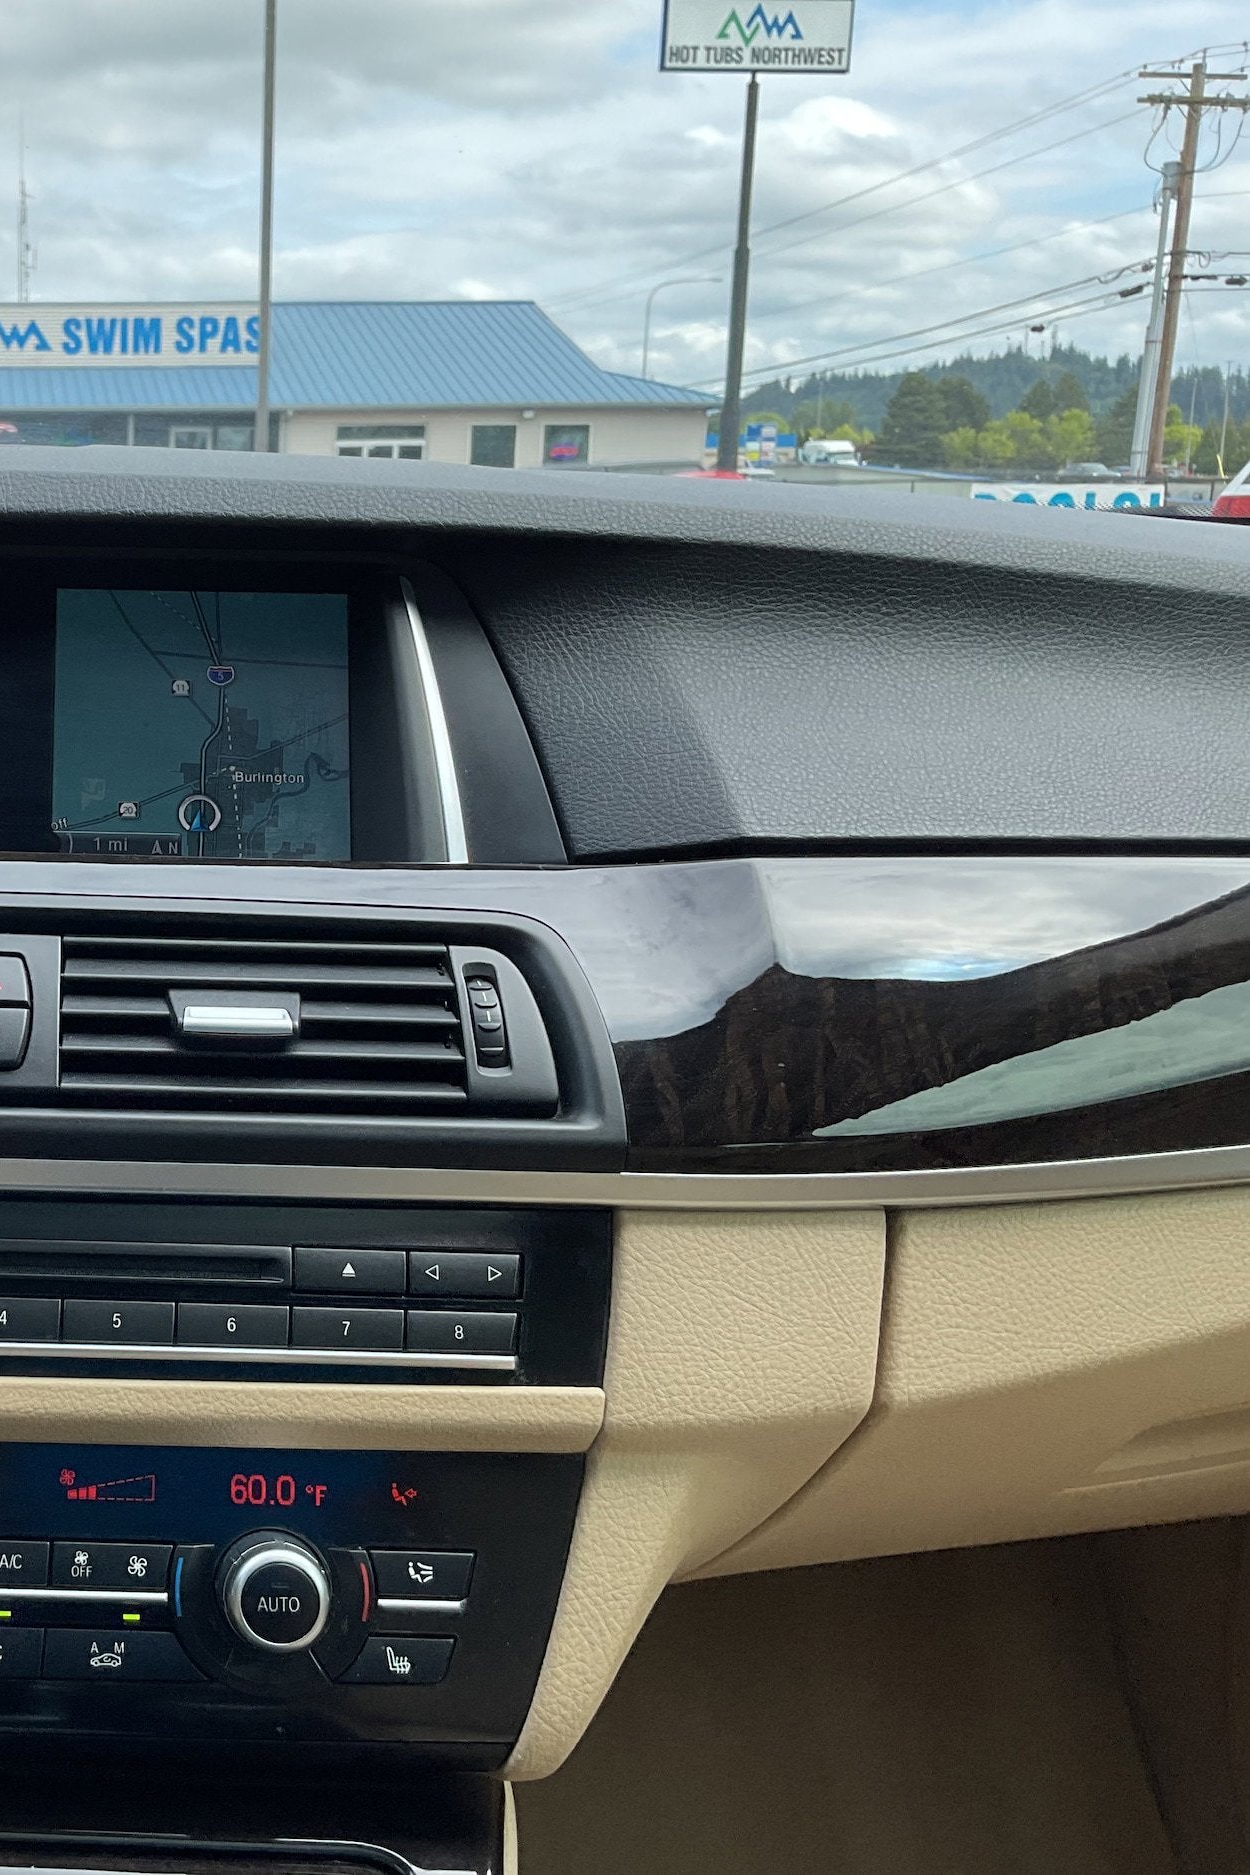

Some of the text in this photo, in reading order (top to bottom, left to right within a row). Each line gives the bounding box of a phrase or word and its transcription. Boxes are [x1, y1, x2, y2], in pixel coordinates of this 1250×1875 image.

[669, 46, 846, 66] HOT TUBS NORTHWEST
[62, 317, 162, 354] SWIM
[174, 316, 261, 354] SPAS
[235, 771, 304, 785] Burlington
[93, 838, 127, 851] 1 mi
[112, 1313, 122, 1328] 5
[227, 1317, 237, 1332] 6
[342, 1321, 351, 1336] 7
[454, 1325, 464, 1340] 8
[230, 1474, 296, 1505] 60.0
[0, 1554, 22, 1569] A/C
[71, 1565, 92, 1578] OFF
[257, 1596, 300, 1613] AUTO
